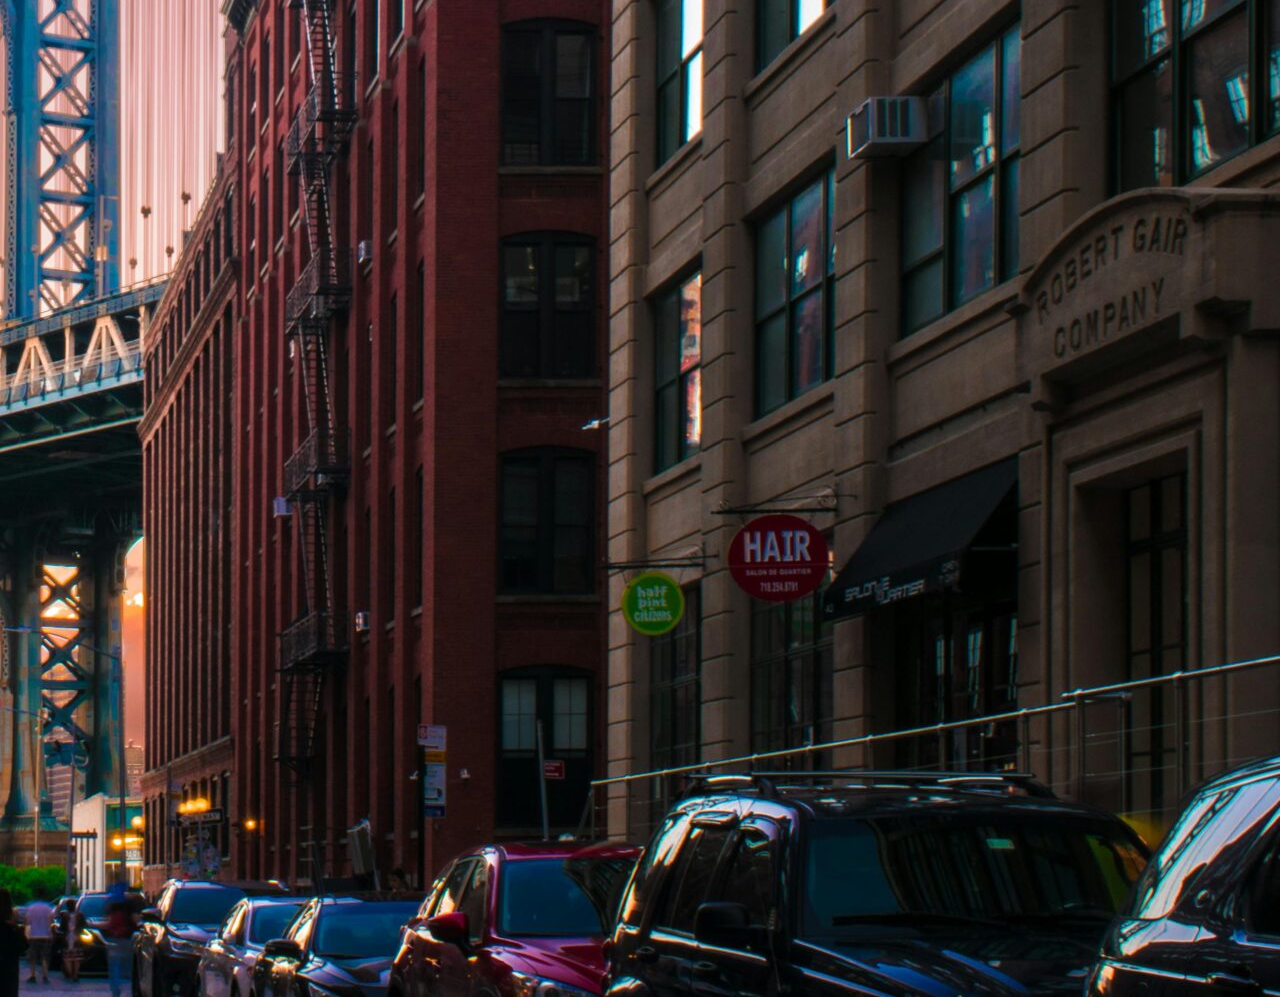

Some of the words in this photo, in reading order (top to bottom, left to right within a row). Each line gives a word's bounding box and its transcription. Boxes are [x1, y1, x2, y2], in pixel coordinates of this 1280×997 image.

[1036, 224, 1123, 325] ROBERT
[1133, 217, 1188, 255] GAIR
[1054, 277, 1165, 358] COMPANY
[743, 529, 812, 563] HAIR
[745, 569, 768, 577] SALON
[768, 568, 777, 576] DE
[779, 567, 812, 575] QUARTIER
[636, 585, 667, 599] half
[844, 581, 877, 602] SALON
[638, 598, 667, 610] pint
